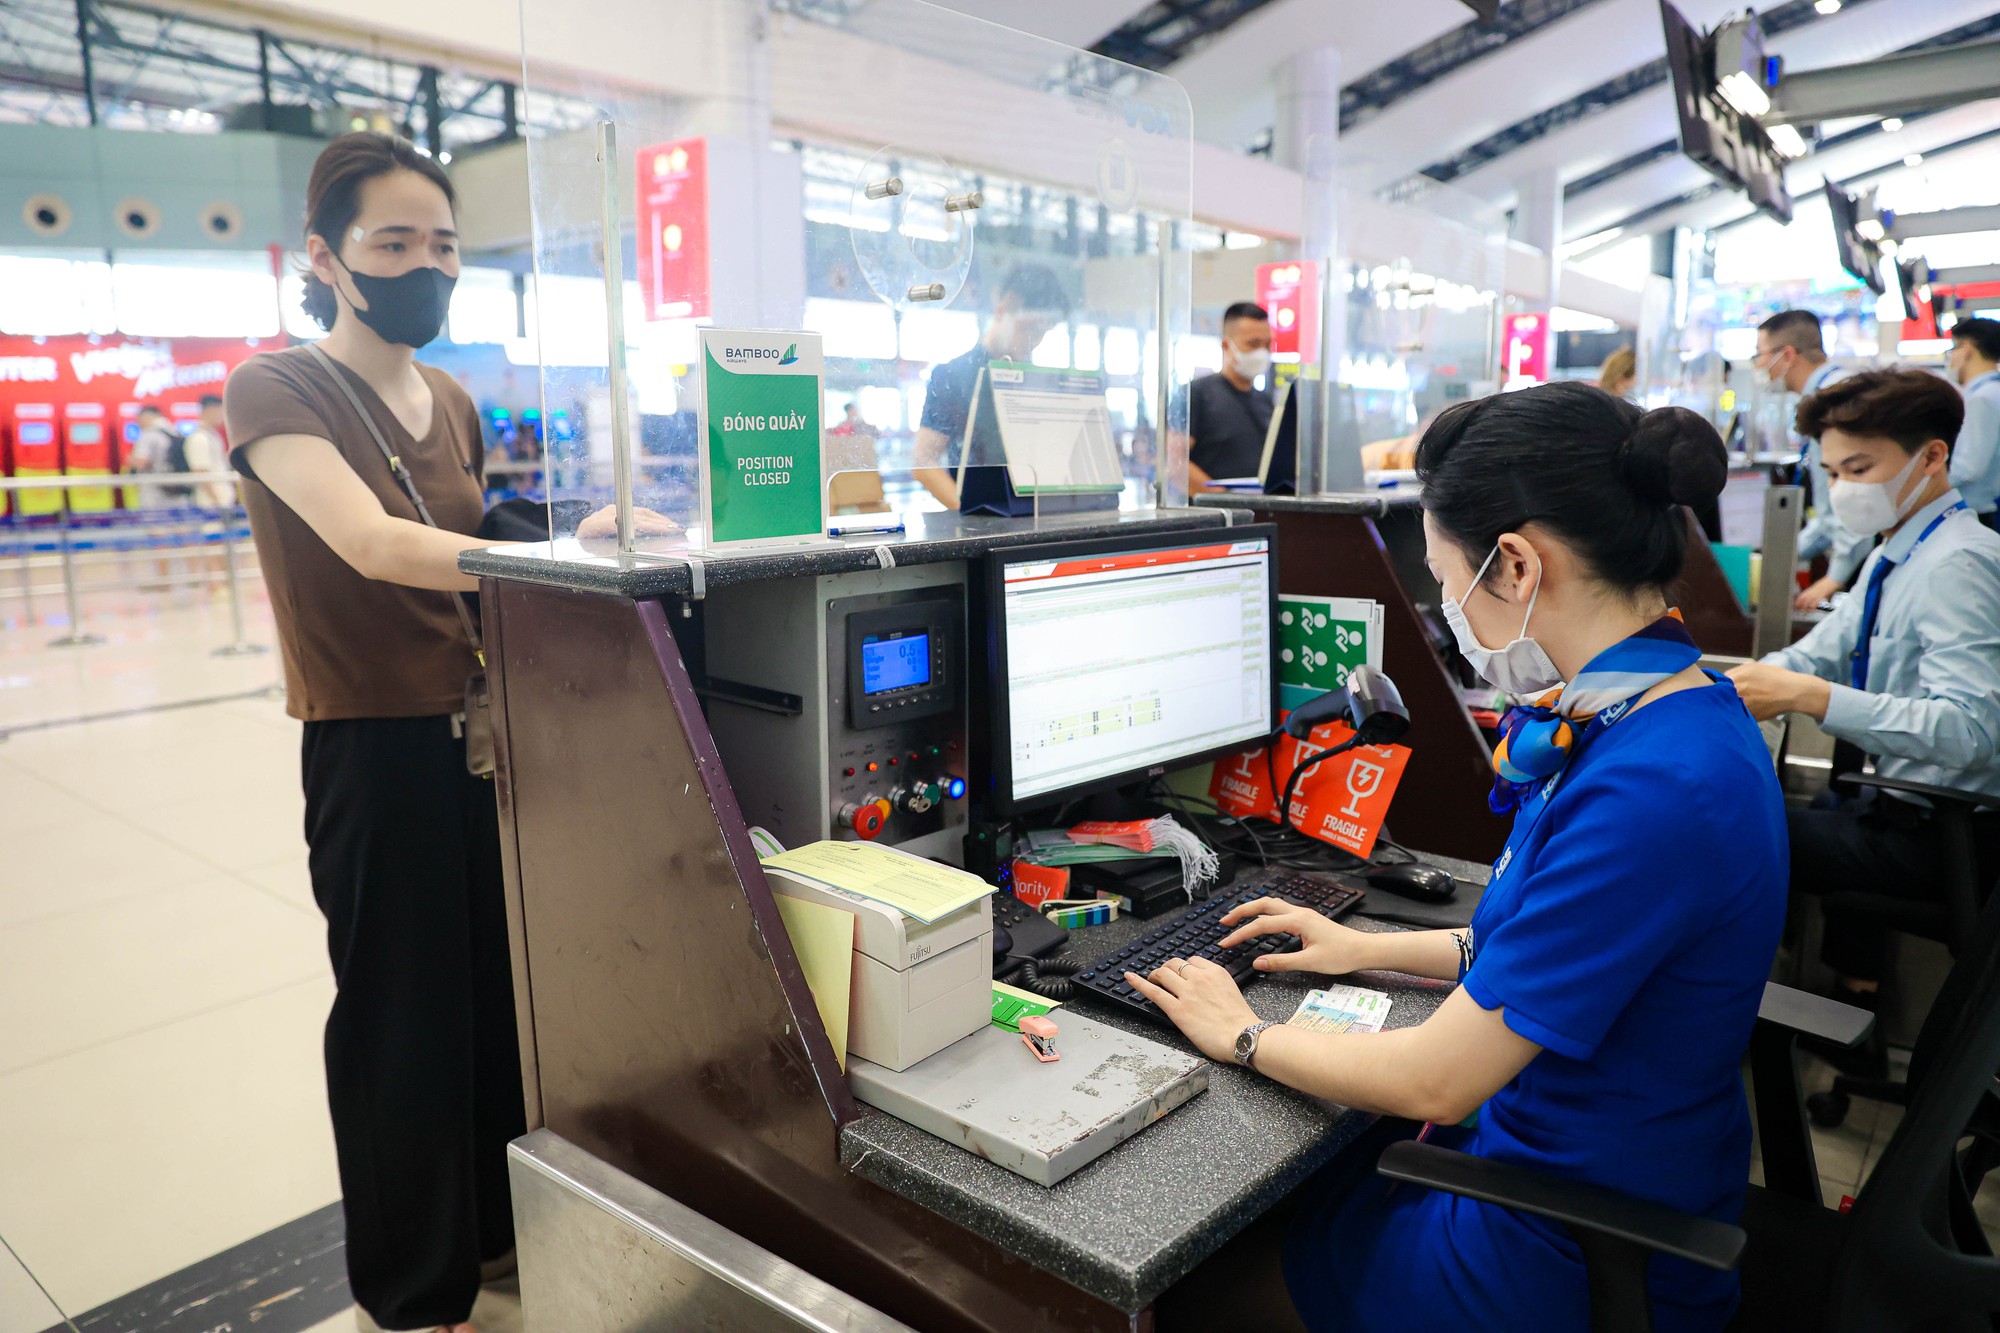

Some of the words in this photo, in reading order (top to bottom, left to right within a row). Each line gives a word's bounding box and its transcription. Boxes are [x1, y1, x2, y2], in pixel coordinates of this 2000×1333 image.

[725, 348, 780, 359] BAMBOO
[722, 411, 766, 432] ĐÓNG
[768, 409, 807, 431] QUẦY
[737, 456, 793, 471] POSITION
[744, 471, 790, 486] CLOSED
[899, 643, 916, 658] 0.5
[1221, 776, 1259, 800] FRAGILE
[1322, 813, 1368, 842] FRAGILE
[1495, 846, 1512, 881] HGS
[910, 944, 931, 962] FUJITSU
